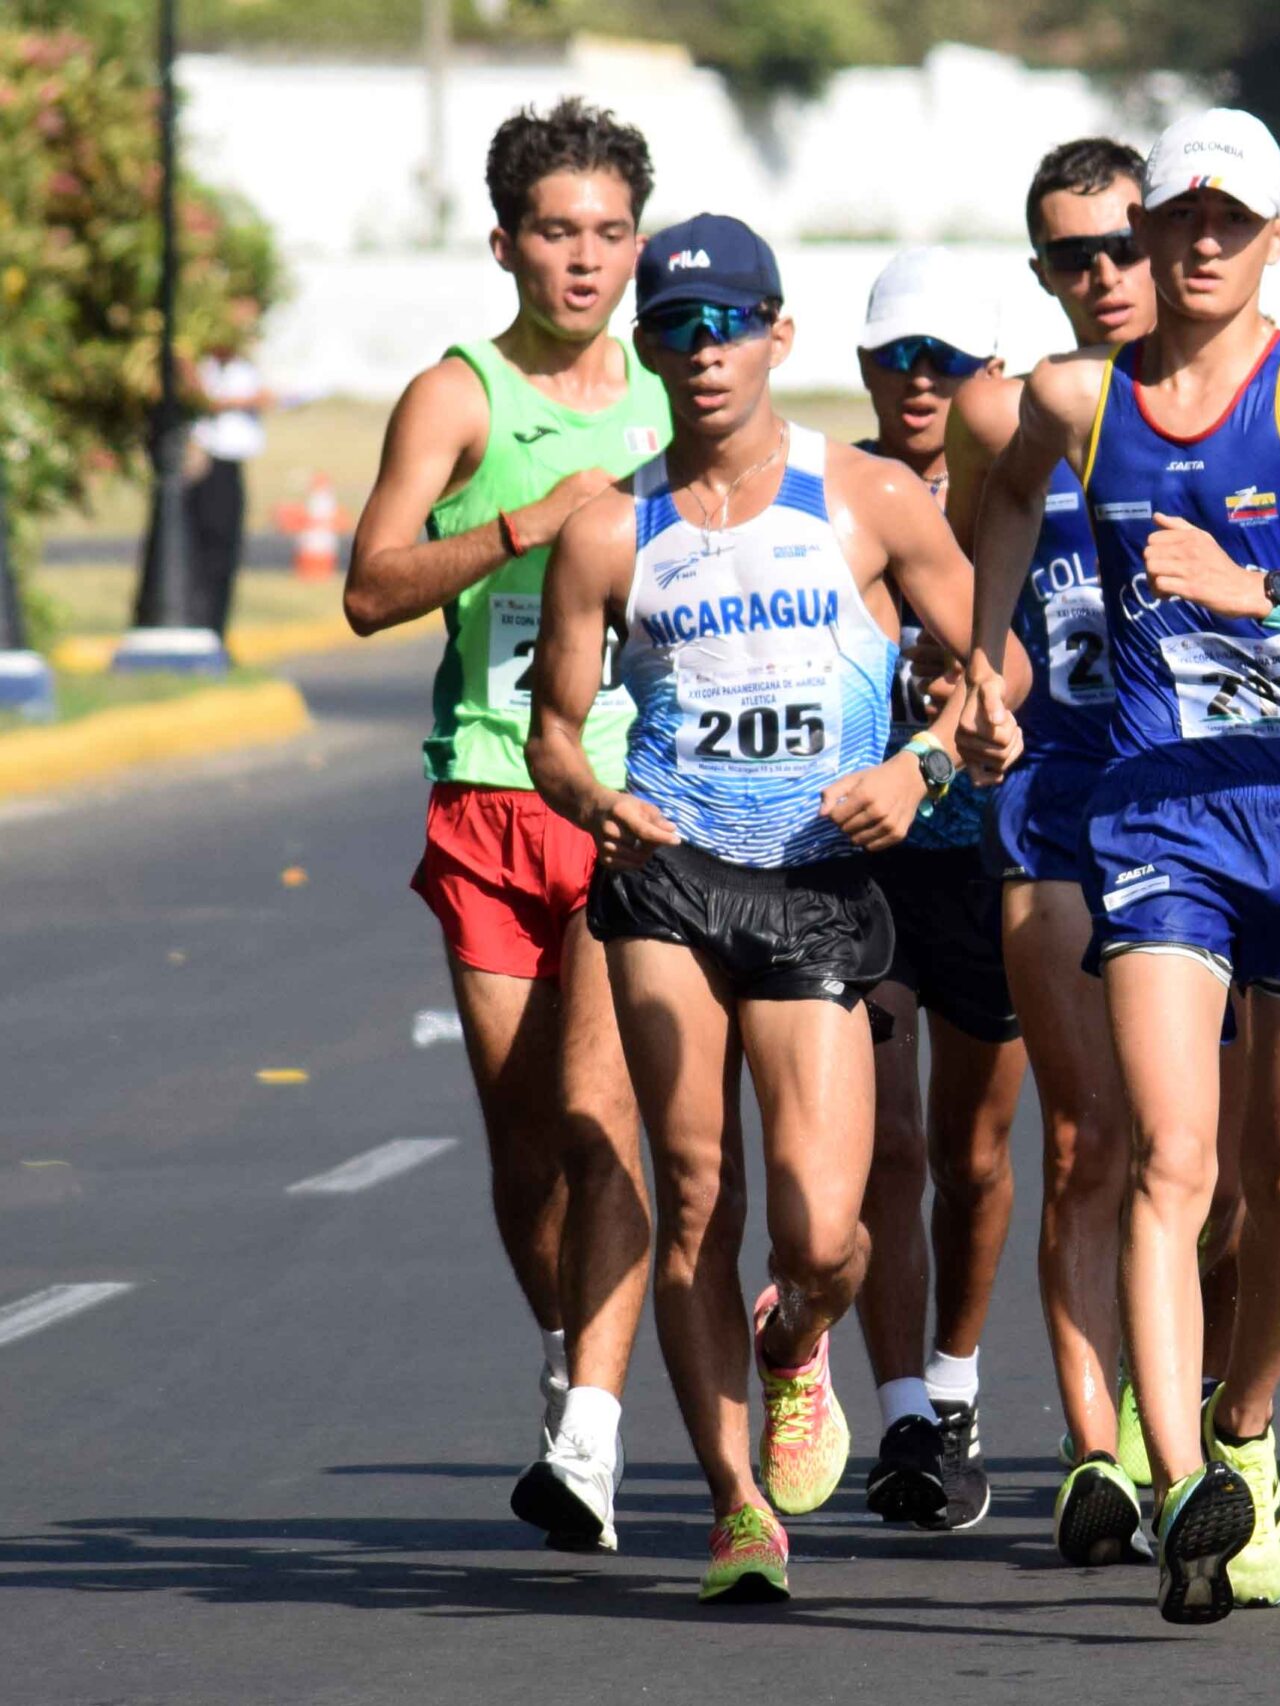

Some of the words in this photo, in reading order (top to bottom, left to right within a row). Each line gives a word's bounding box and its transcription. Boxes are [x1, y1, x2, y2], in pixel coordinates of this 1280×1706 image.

[669, 249, 711, 271] FILA
[1166, 461, 1205, 471] SAETA
[515, 614, 535, 625] COPA
[641, 588, 839, 648] NICARAGUA
[702, 688, 721, 698] COPA
[722, 680, 780, 696] PANAMERICANA
[783, 680, 792, 688] DE
[741, 694, 777, 706] ATLETICA
[694, 703, 825, 759] 205
[1115, 864, 1155, 884] SAETA
